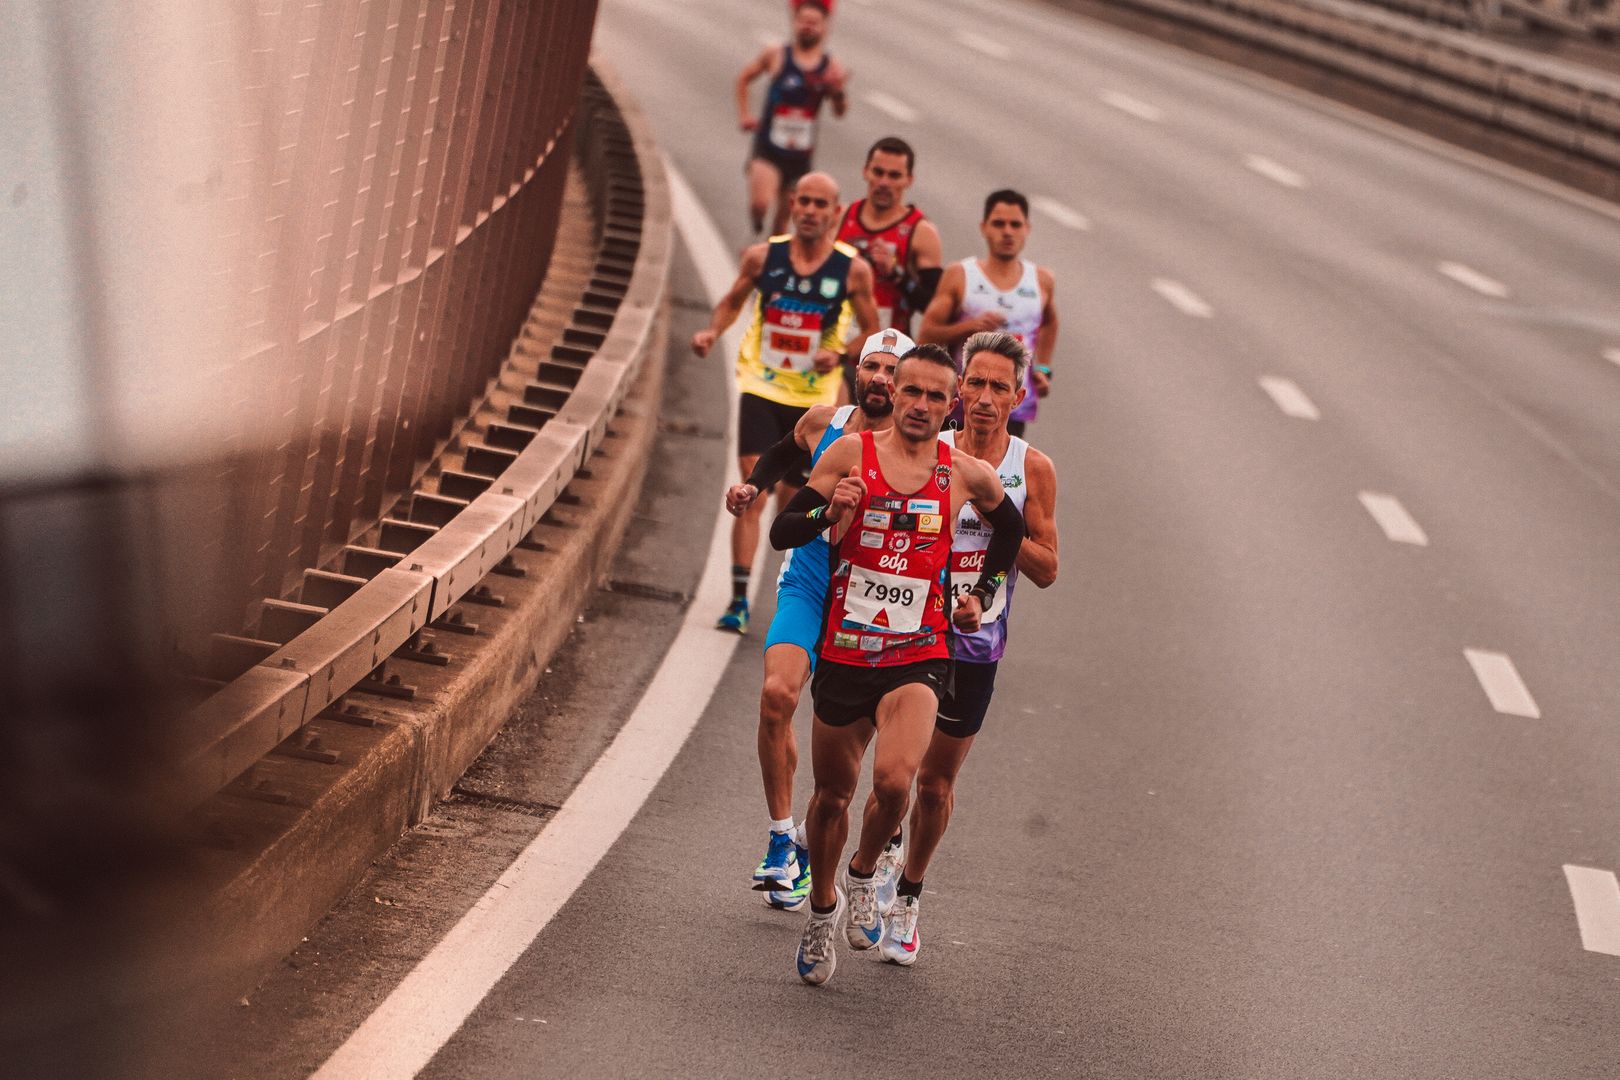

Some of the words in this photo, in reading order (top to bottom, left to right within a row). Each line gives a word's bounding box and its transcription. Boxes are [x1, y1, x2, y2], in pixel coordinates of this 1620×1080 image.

[879, 553, 908, 574] edp
[959, 552, 985, 571] edp
[864, 580, 914, 606] 7999
[950, 583, 972, 599] 43
